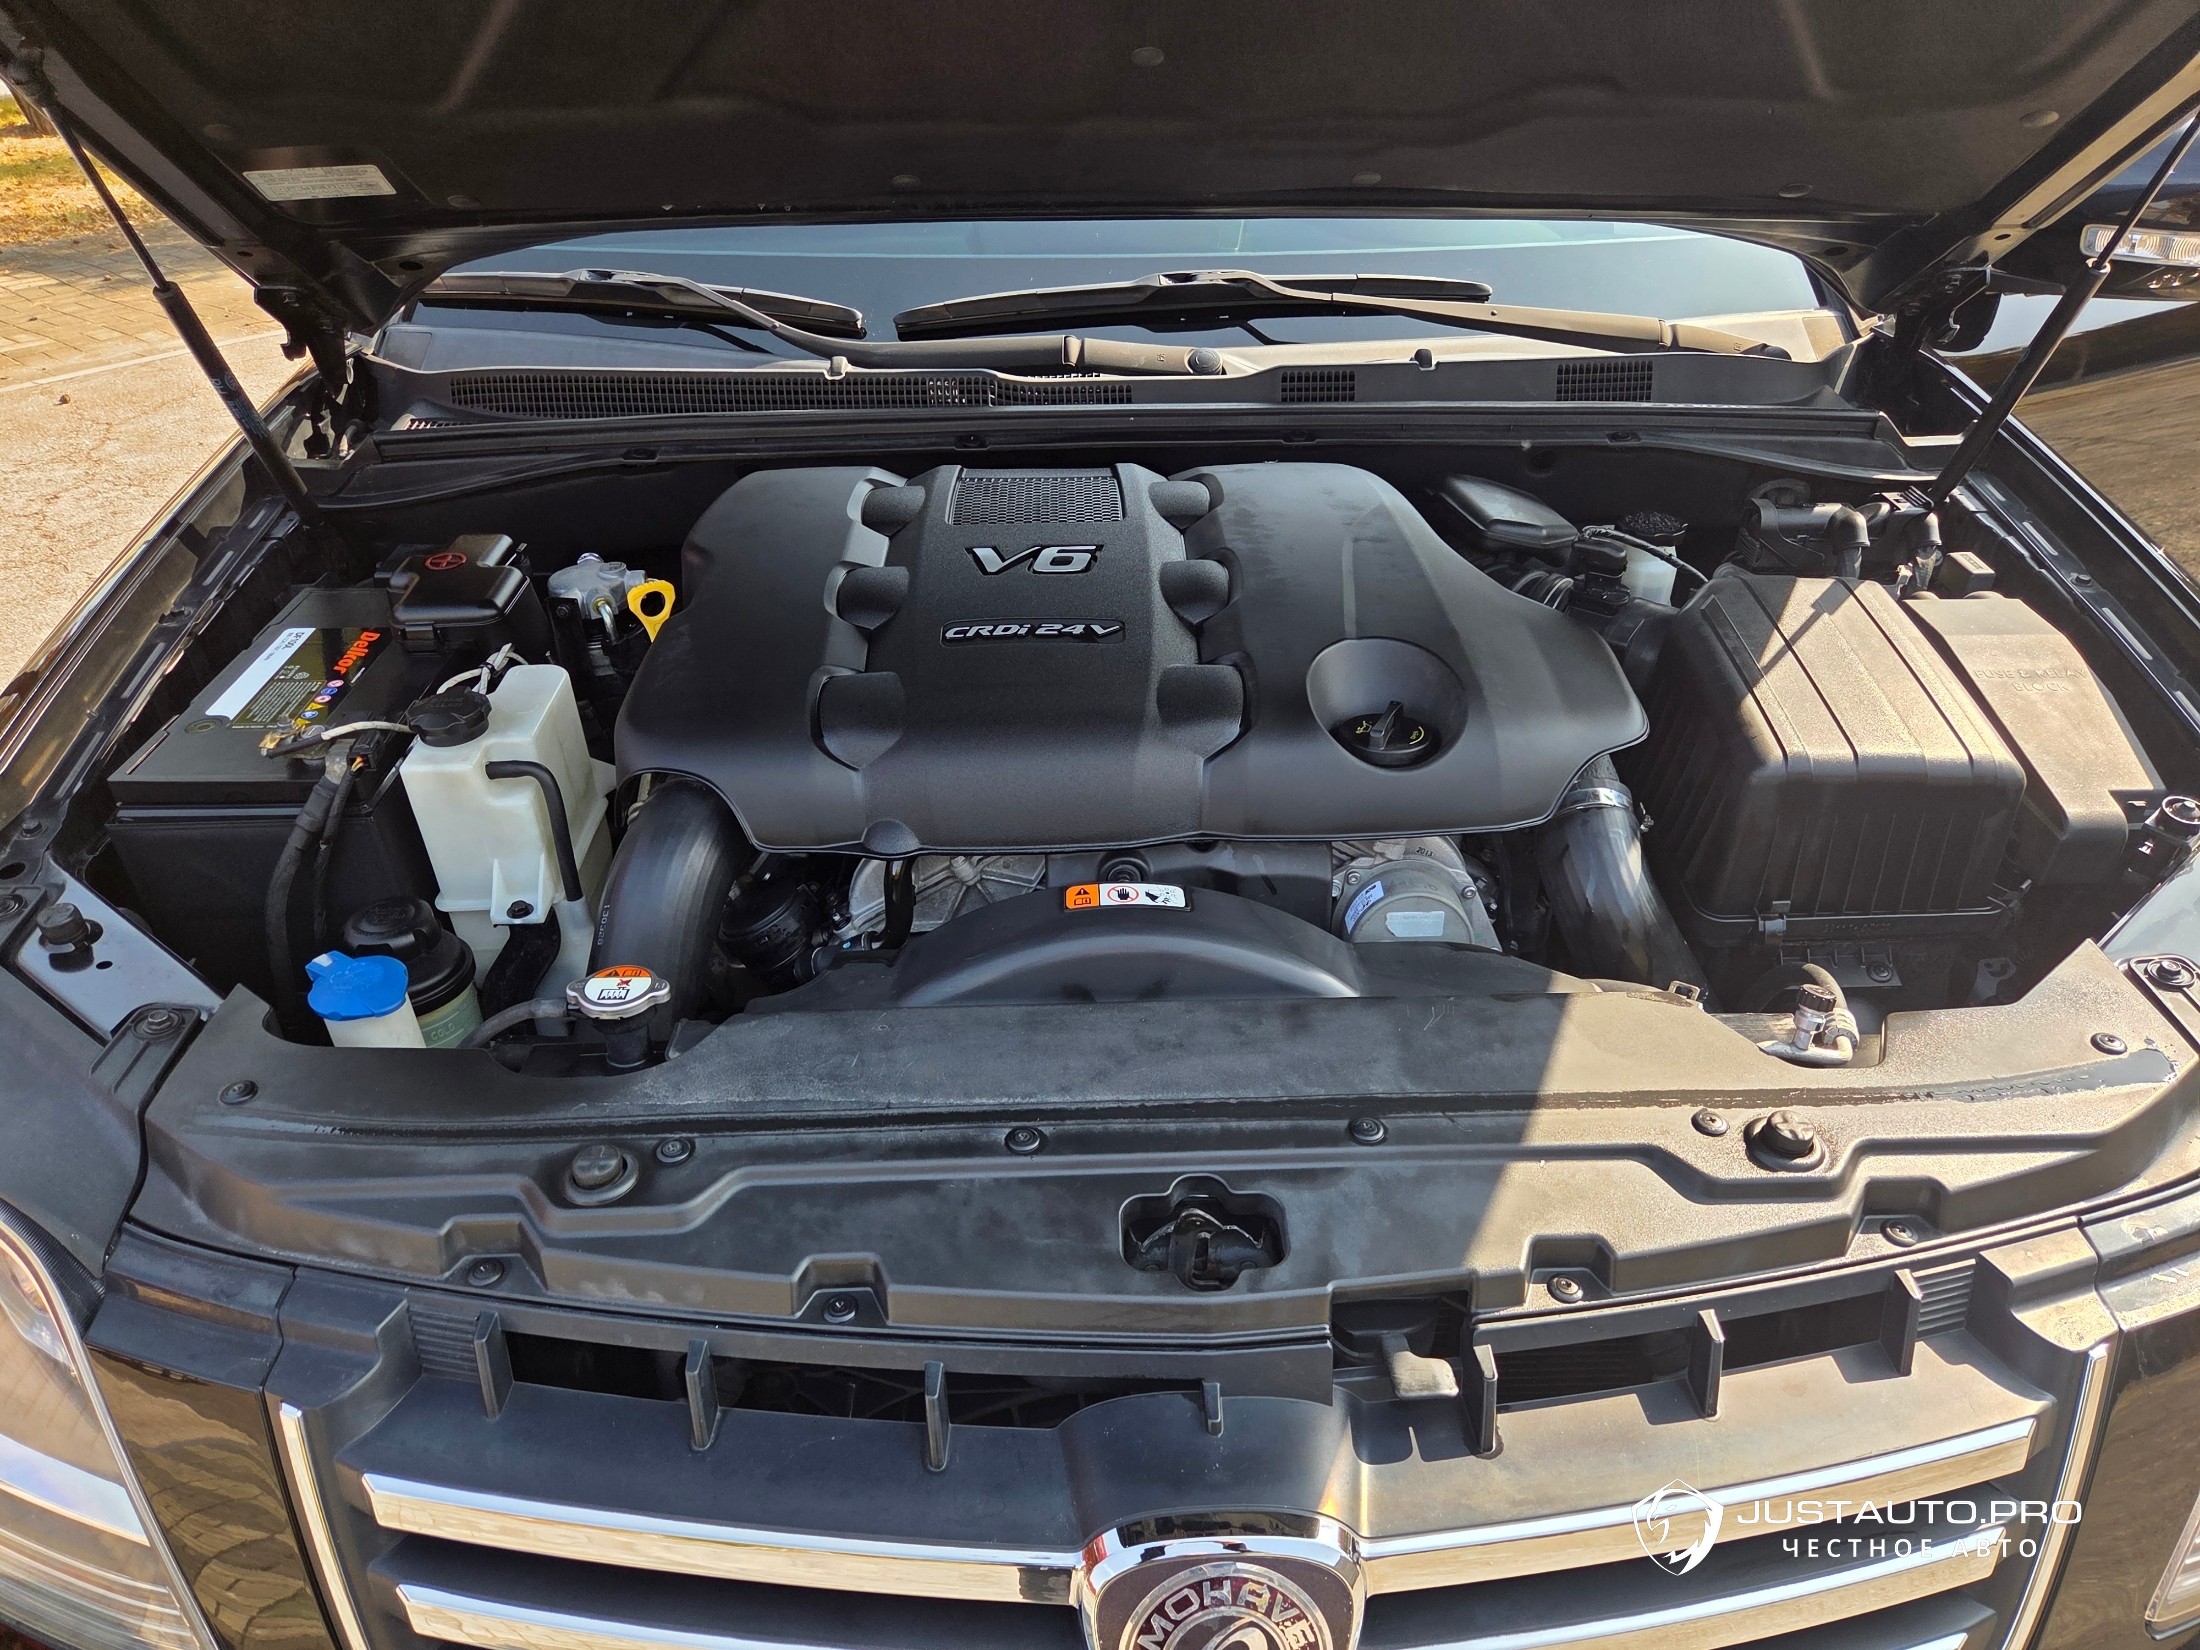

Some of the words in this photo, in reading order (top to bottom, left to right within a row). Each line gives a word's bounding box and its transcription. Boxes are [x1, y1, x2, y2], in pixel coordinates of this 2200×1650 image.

[970, 545, 1099, 574] V6
[945, 623, 1032, 640] CRDi
[1034, 623, 1121, 638] 24V
[333, 630, 381, 676] Delkor
[1973, 669, 2014, 679] FUSE
[2034, 668, 2088, 679] RELAY
[2011, 682, 2071, 692] BLOCK
[1416, 846, 1434, 857] 2013
[430, 1022, 456, 1041] COLD
[1137, 1579, 1316, 1650] MOHAVE
